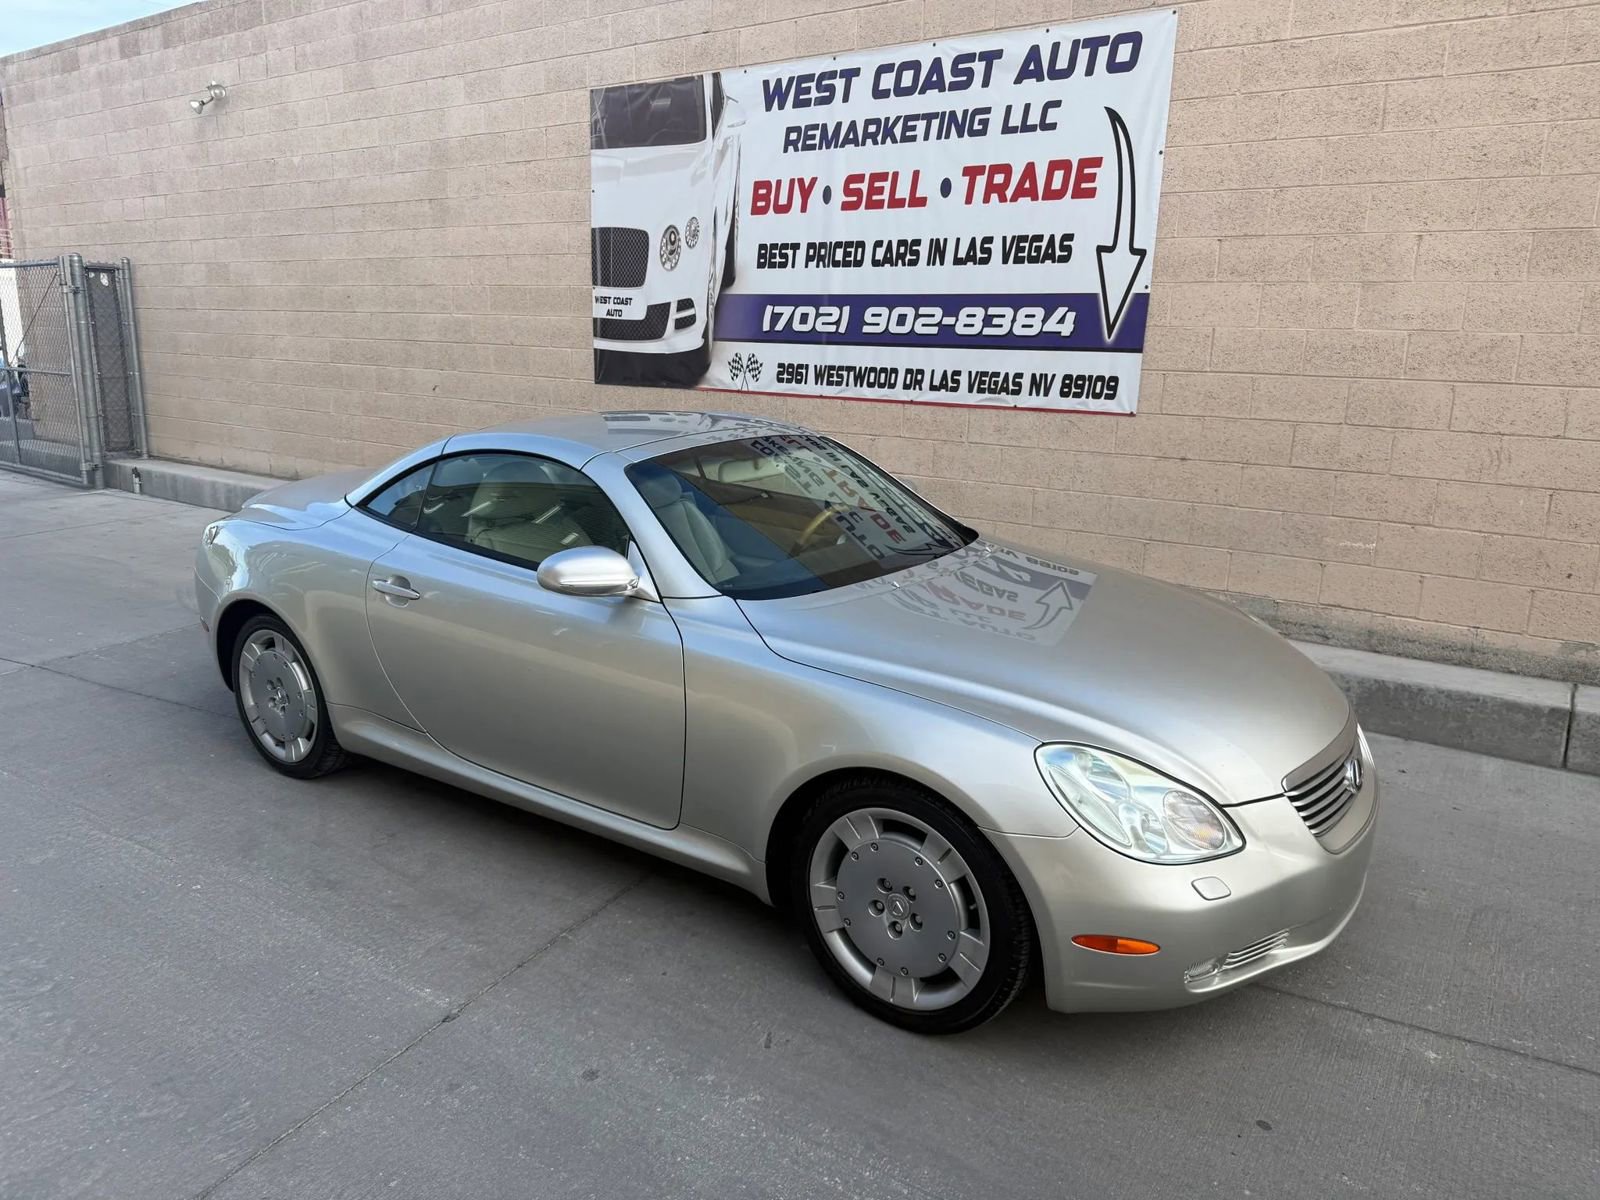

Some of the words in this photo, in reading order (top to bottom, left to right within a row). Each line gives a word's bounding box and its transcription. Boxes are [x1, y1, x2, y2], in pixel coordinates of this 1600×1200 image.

[762, 67, 861, 112] WEST
[871, 49, 1004, 100] COAST
[1013, 31, 1143, 85] AUTO
[783, 106, 992, 154] REMARKETING
[1001, 100, 1062, 135] LLC
[750, 176, 818, 216] BUY
[840, 169, 928, 211] SELL
[962, 156, 1103, 205] TRADE
[756, 242, 802, 269] BEST
[804, 240, 866, 269] PRICED
[871, 238, 922, 268] CARS
[926, 237, 948, 267] IN
[952, 235, 994, 266] LAS
[1002, 233, 1075, 264] VEGAS
[595, 296, 611, 304] WEST
[612, 297, 633, 306] COAST
[606, 309, 623, 317] AUTO
[762, 304, 850, 334] (702)
[861, 306, 1077, 337] 902-8384
[776, 362, 809, 385] 2961
[814, 364, 899, 390] WESTWOOD
[902, 368, 925, 391] DR
[929, 368, 962, 393] LAS
[968, 370, 1024, 396] VEGAS
[1028, 372, 1056, 397] NV
[1059, 373, 1119, 400] 89109
